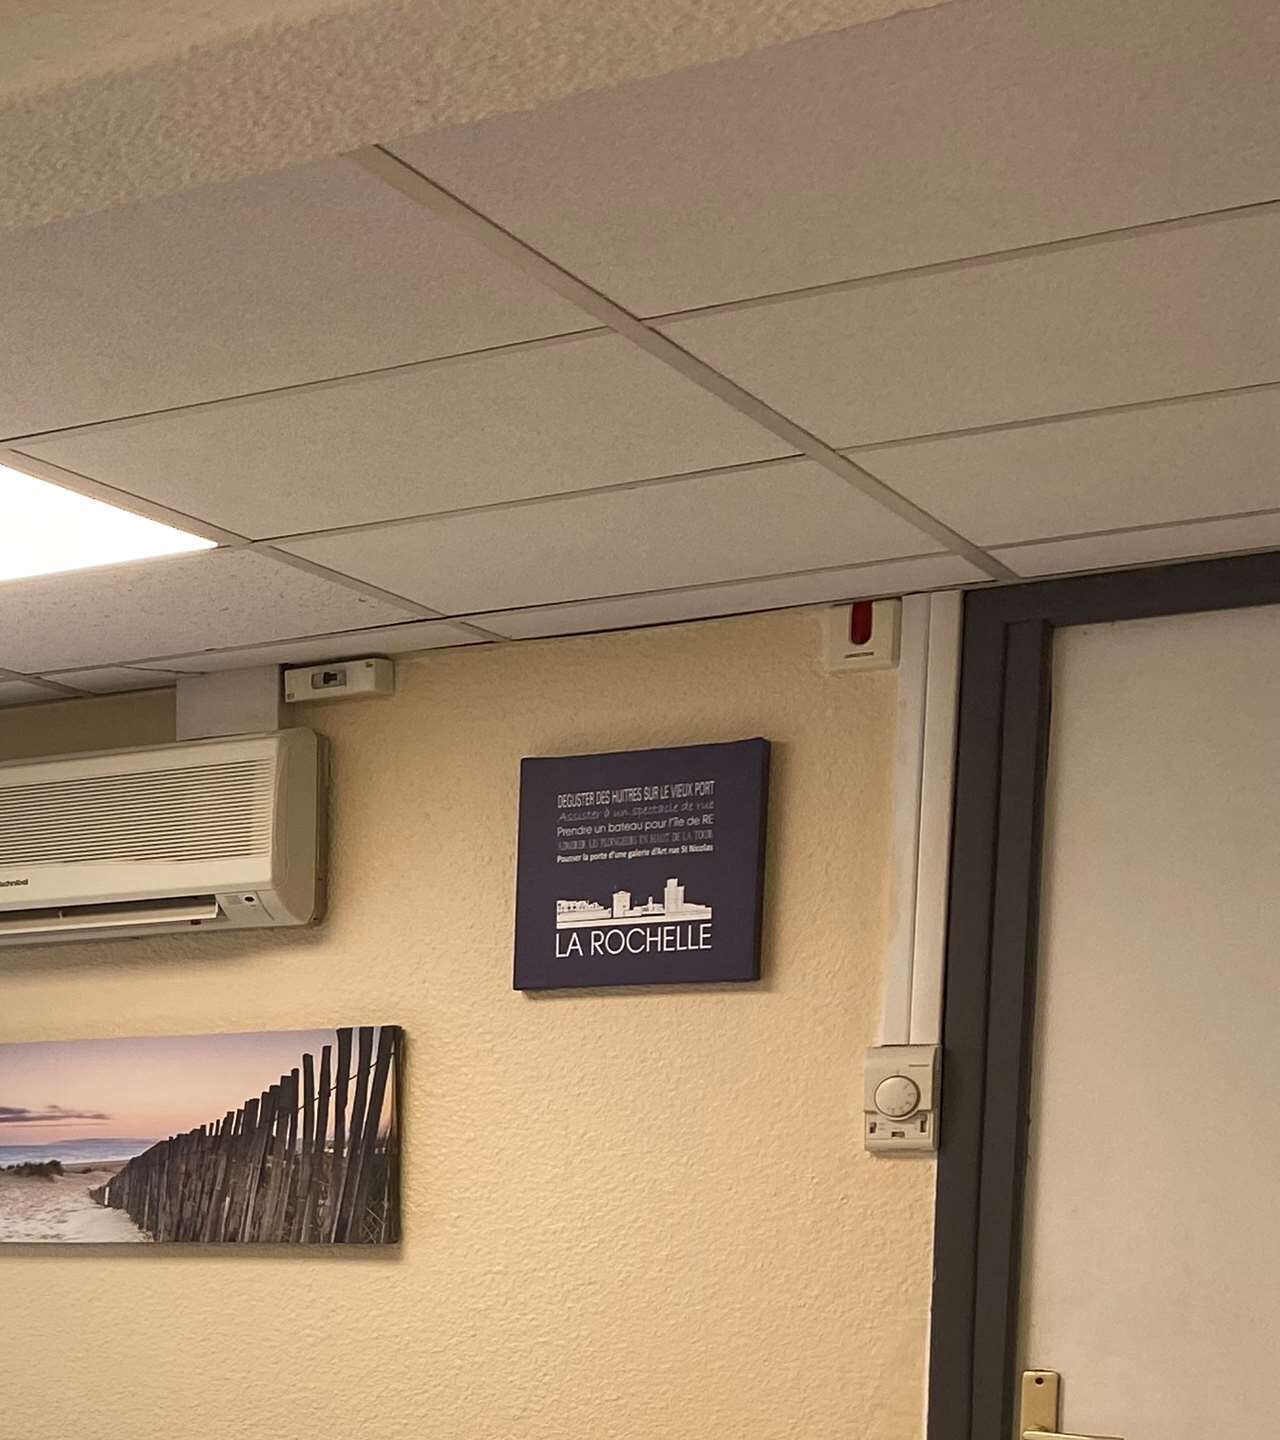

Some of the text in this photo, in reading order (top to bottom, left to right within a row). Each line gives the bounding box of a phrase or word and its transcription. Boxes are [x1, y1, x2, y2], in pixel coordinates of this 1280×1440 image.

[557, 791, 594, 808] DEGUSTER
[595, 789, 611, 805] DES
[643, 785, 660, 801] SUR
[660, 784, 670, 799] LE
[671, 782, 694, 798] VIEUX
[694, 780, 715, 796] PORT
[557, 822, 592, 837] Prendre
[594, 824, 606, 834] un
[608, 819, 643, 833] bateau
[644, 818, 668, 832] pour
[686, 814, 700, 826] de
[589, 851, 608, 862] porte
[555, 923, 713, 958] LA ROCHELLE
